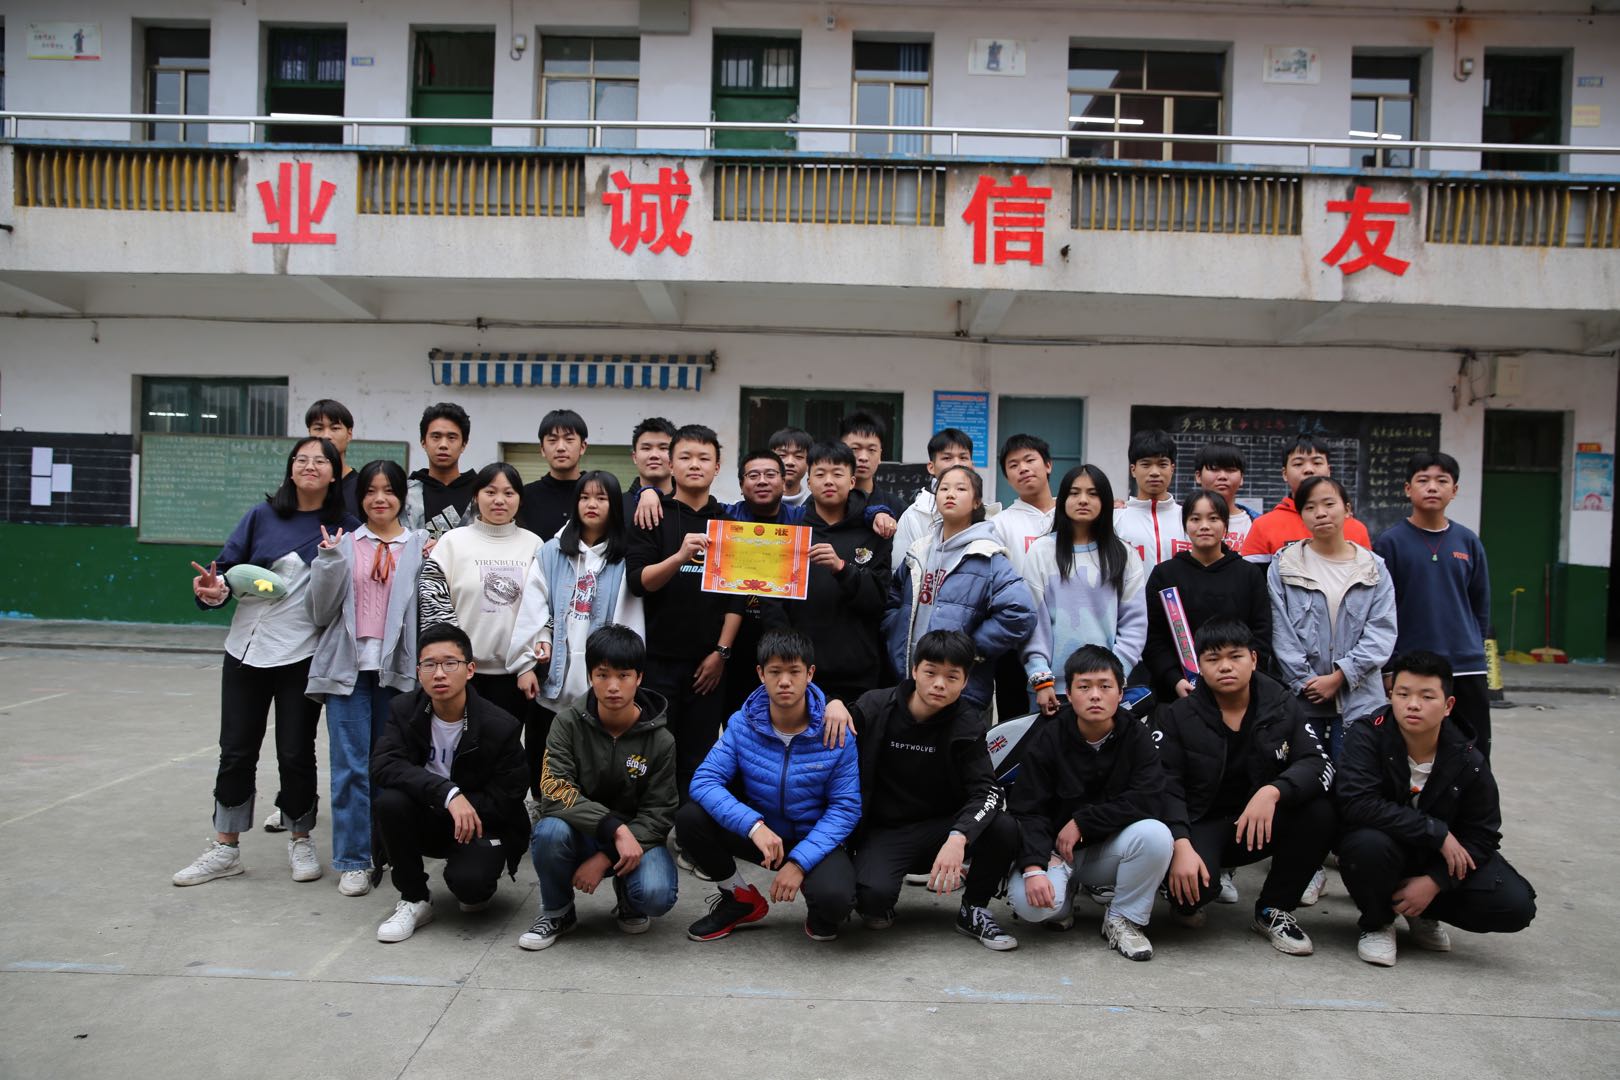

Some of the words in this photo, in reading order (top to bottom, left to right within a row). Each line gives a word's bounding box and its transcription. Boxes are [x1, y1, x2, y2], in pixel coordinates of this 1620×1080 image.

[252, 162, 337, 245] 业
[602, 166, 692, 257] 诚
[962, 175, 1052, 265] 信
[1322, 186, 1412, 277] 友
